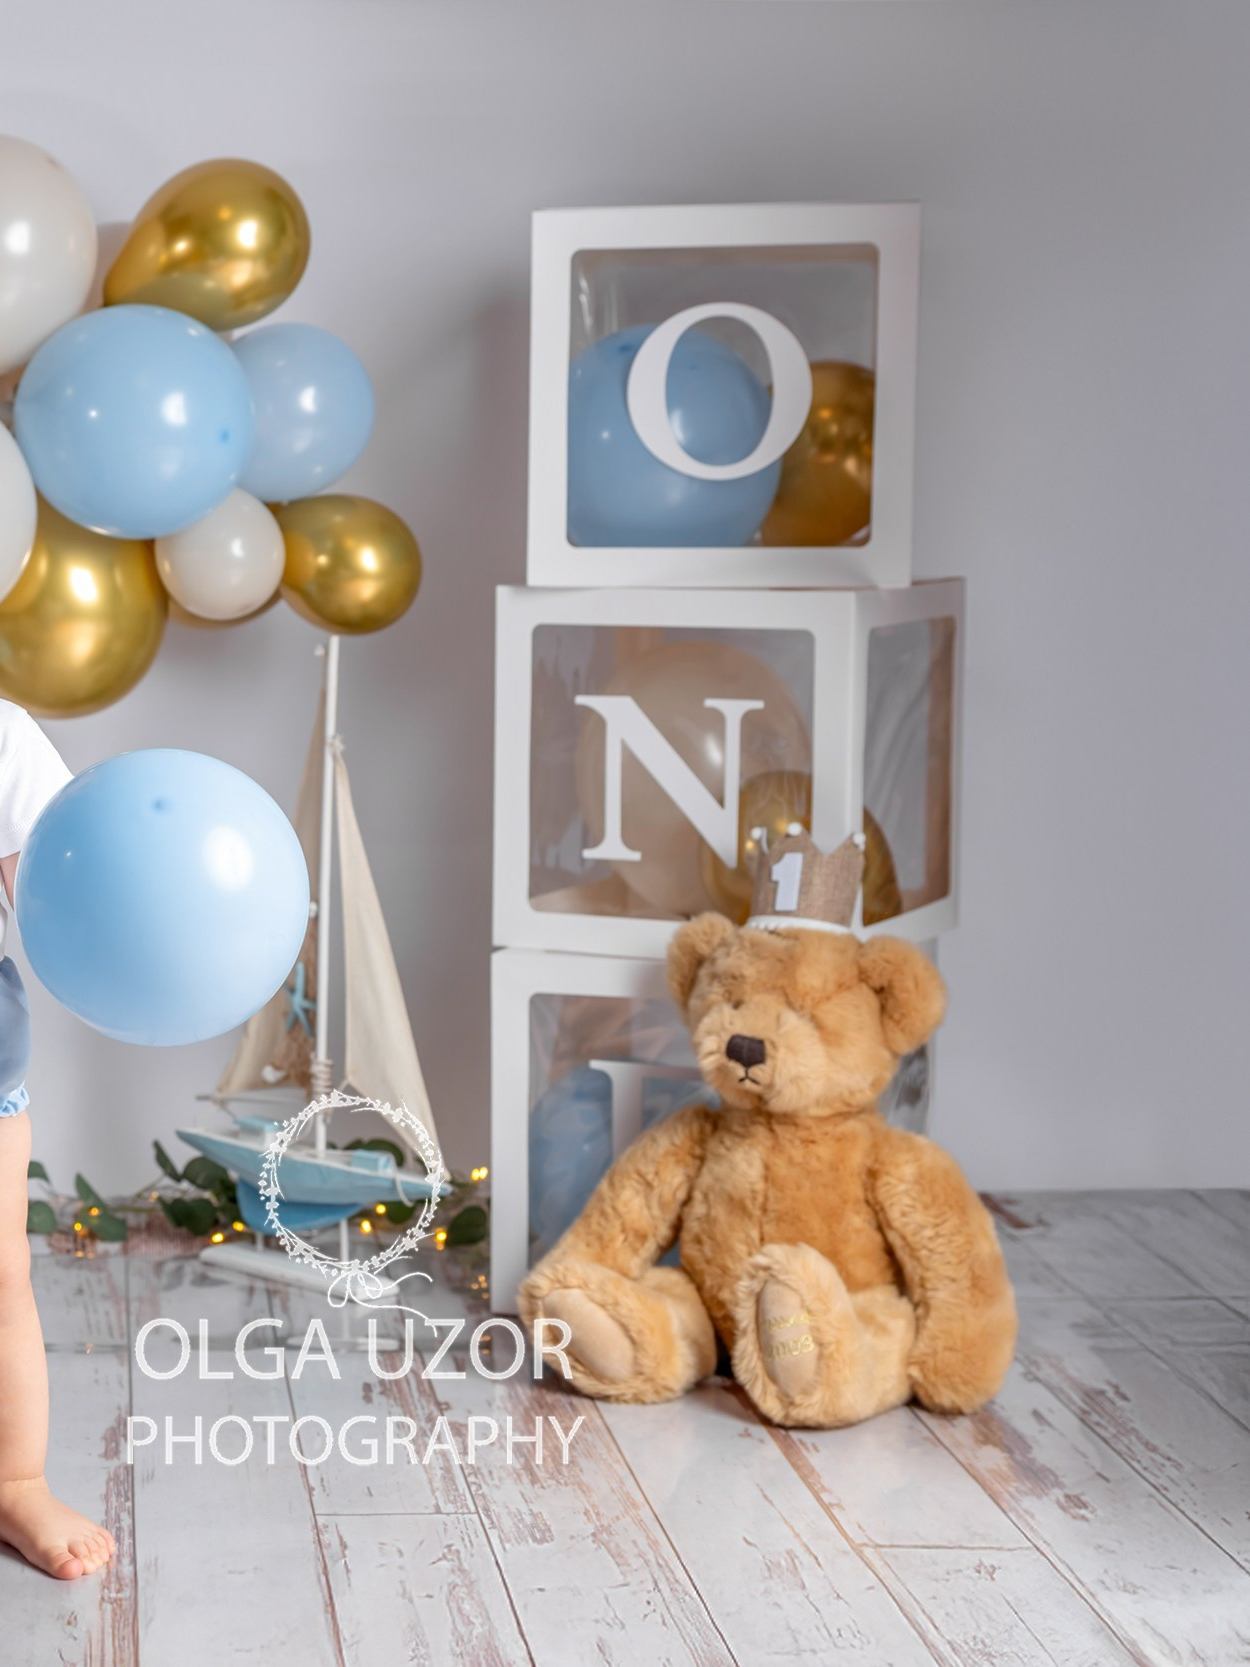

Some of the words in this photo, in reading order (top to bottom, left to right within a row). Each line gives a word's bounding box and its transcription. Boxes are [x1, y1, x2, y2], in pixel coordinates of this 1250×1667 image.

[626, 301, 813, 481] O
[573, 694, 765, 868] N
[771, 852, 804, 912] 1
